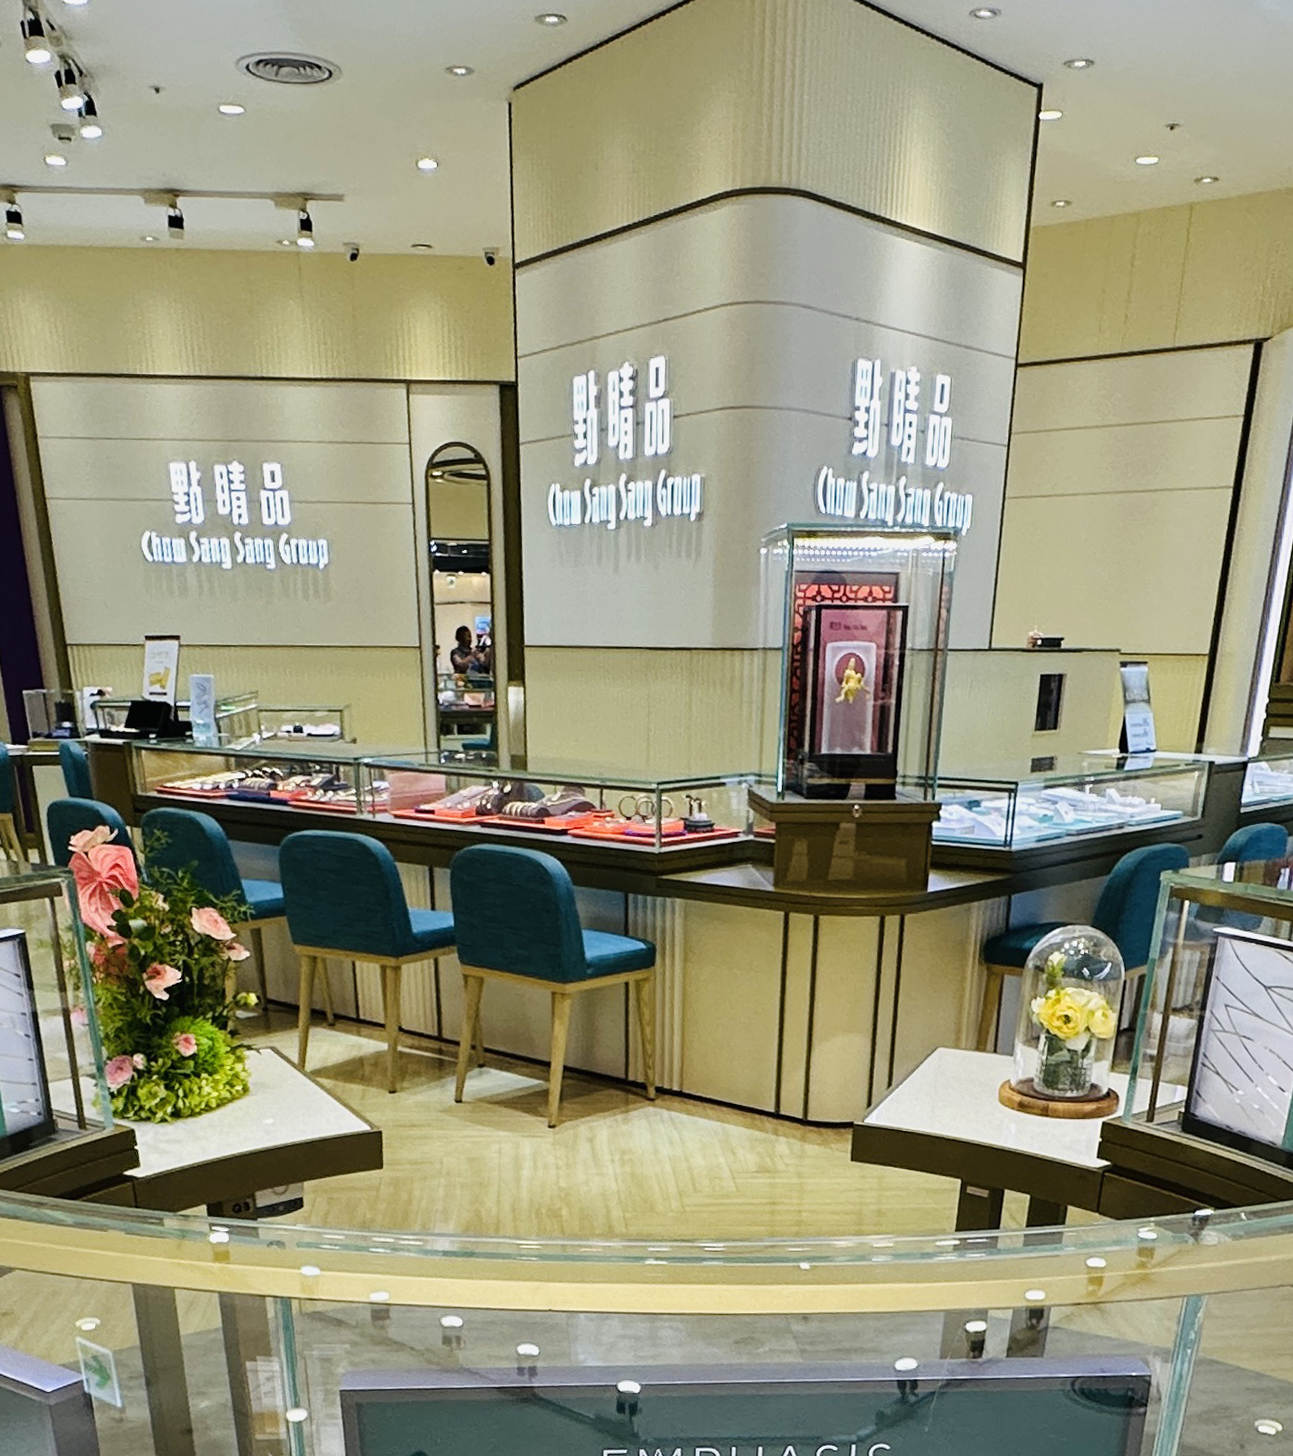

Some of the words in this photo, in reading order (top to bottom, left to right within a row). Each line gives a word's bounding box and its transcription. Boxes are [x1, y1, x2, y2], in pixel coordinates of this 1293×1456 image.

[547, 482, 582, 526] Chow
[583, 477, 616, 530] Sang
[618, 472, 653, 527] Sang
[656, 468, 702, 523] Group
[816, 465, 857, 519] Chow
[859, 470, 896, 527] Sang
[934, 481, 974, 536] Group
[141, 530, 188, 564] Chow
[189, 530, 233, 570] Sang
[234, 531, 277, 570] Sang
[278, 532, 330, 570] Group
